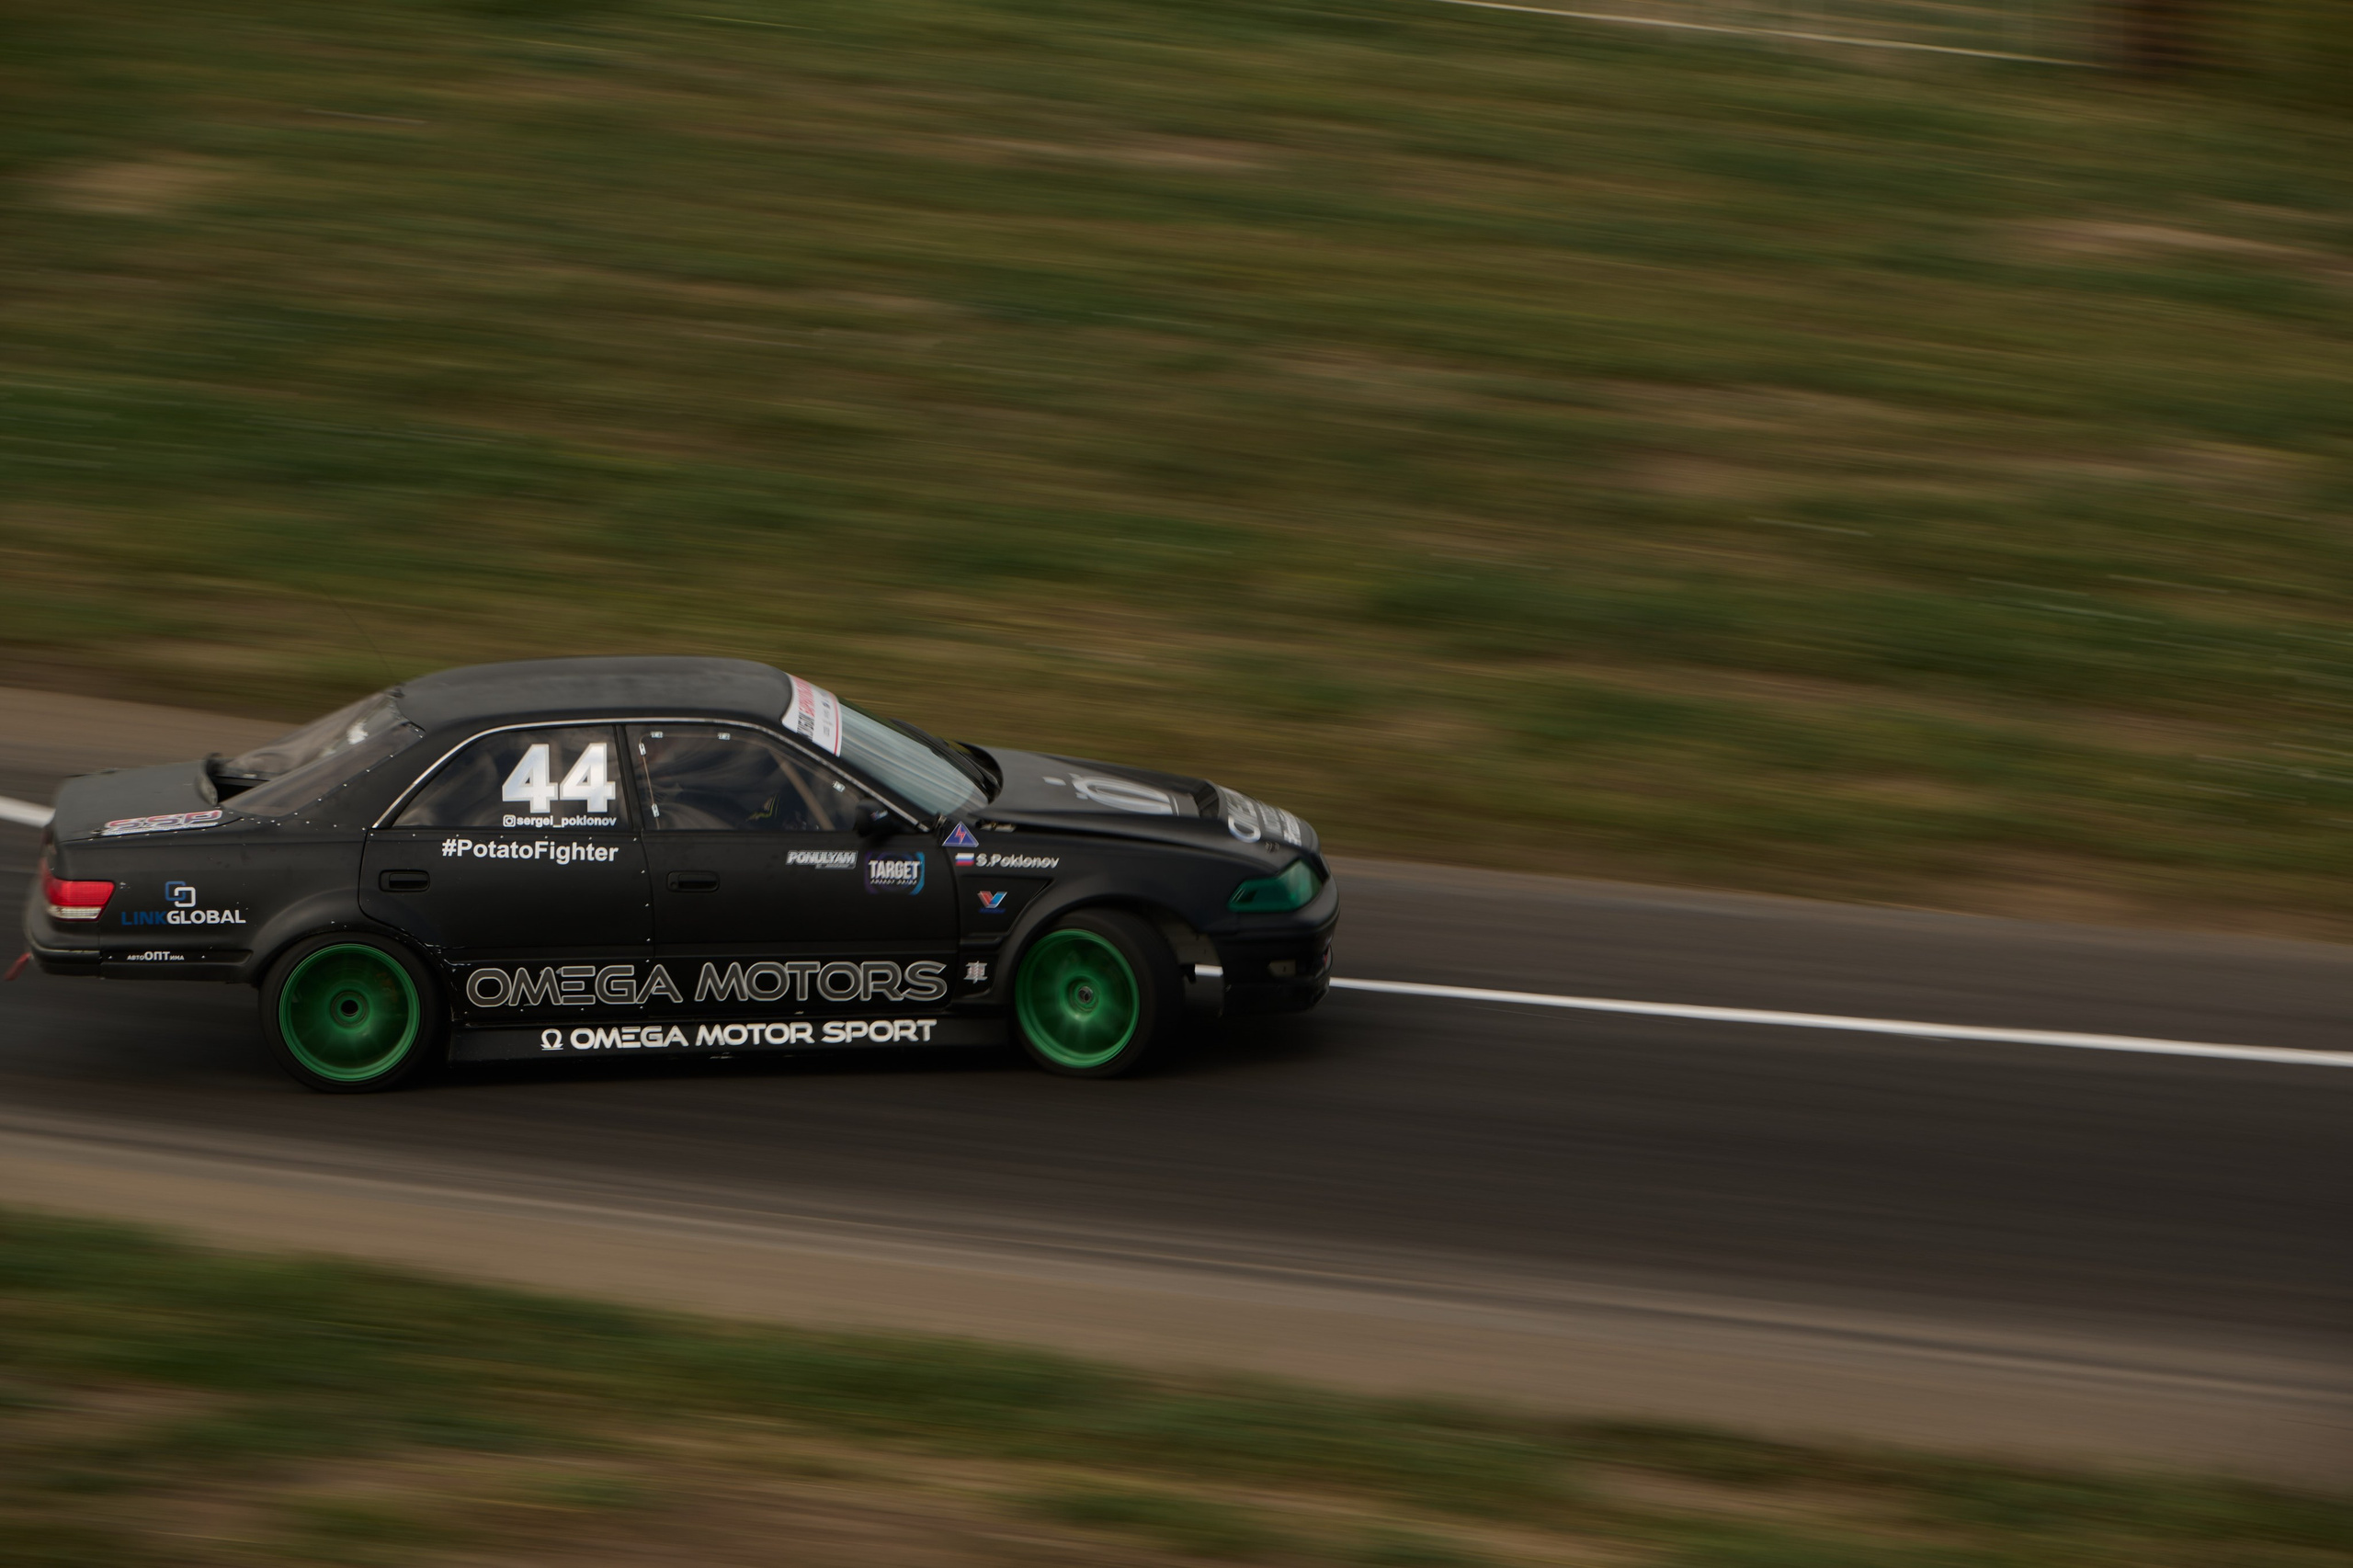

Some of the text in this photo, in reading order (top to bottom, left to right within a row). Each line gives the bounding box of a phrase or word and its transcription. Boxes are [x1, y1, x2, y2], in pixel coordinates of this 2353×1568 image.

[501, 743, 617, 813] 44
[441, 838, 619, 865] #PotatoFighter
[975, 853, 1060, 869] S.Poklonov
[868, 860, 921, 880] TARGET
[466, 964, 684, 1008] OMEGA
[694, 960, 949, 1004] MOTORS
[570, 1025, 687, 1050] OMEGA
[696, 1022, 814, 1047] MOTOR
[822, 1019, 938, 1044] SPORT
